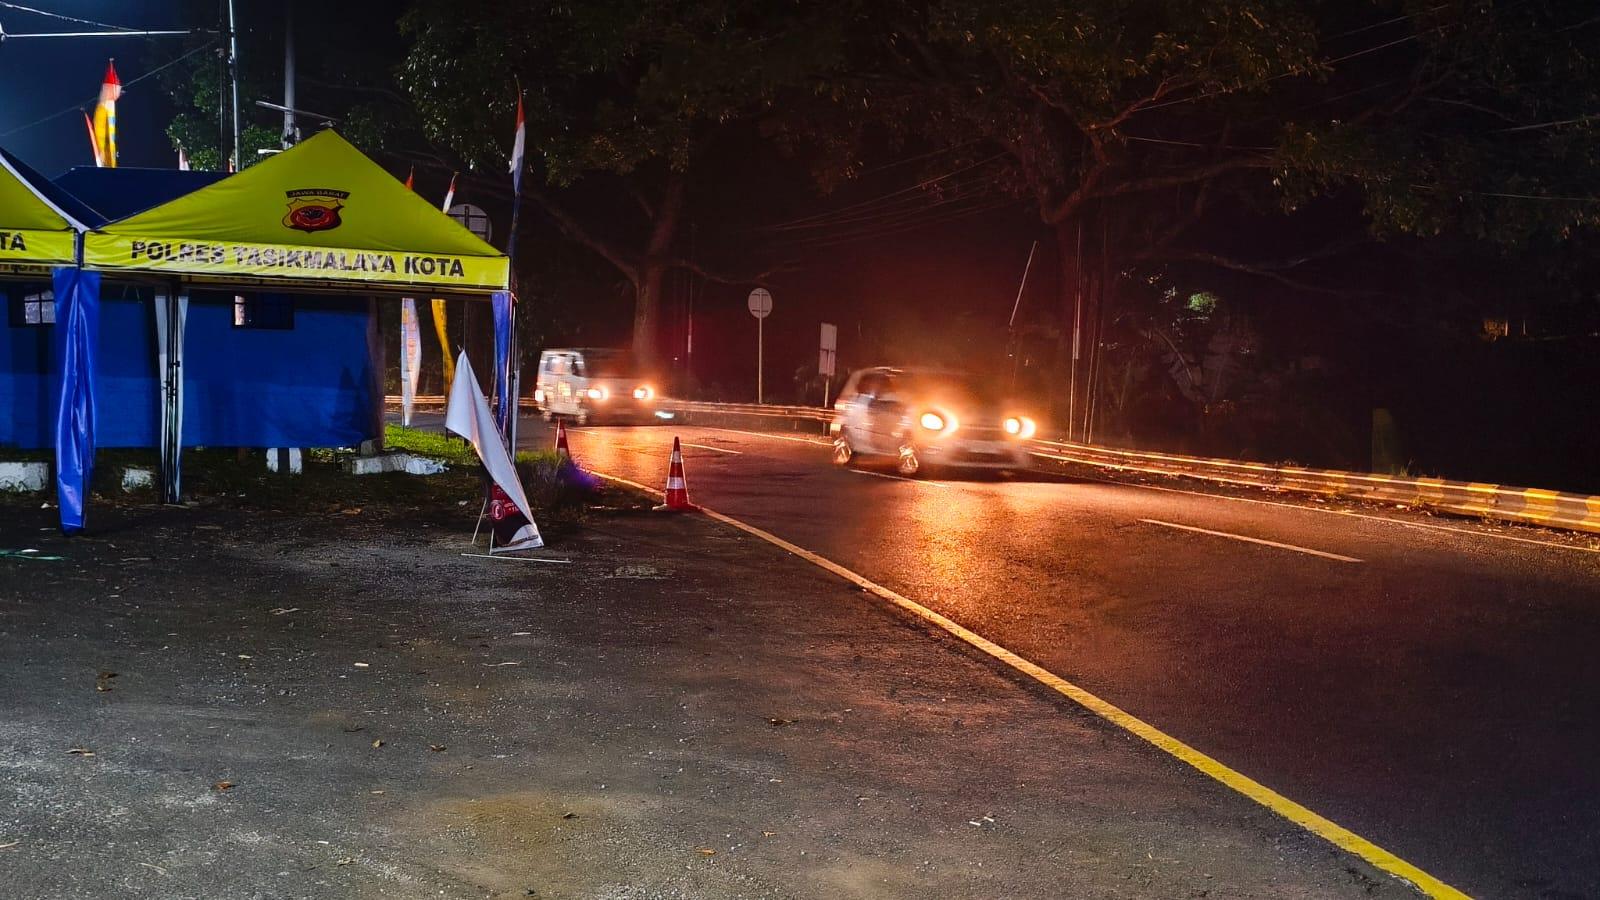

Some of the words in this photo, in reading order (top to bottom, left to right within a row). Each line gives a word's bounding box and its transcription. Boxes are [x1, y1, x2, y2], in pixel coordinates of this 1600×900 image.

[131, 240, 225, 264] POLRES
[233, 246, 396, 274] TASIKMALAYA
[404, 256, 465, 277] KOTA
